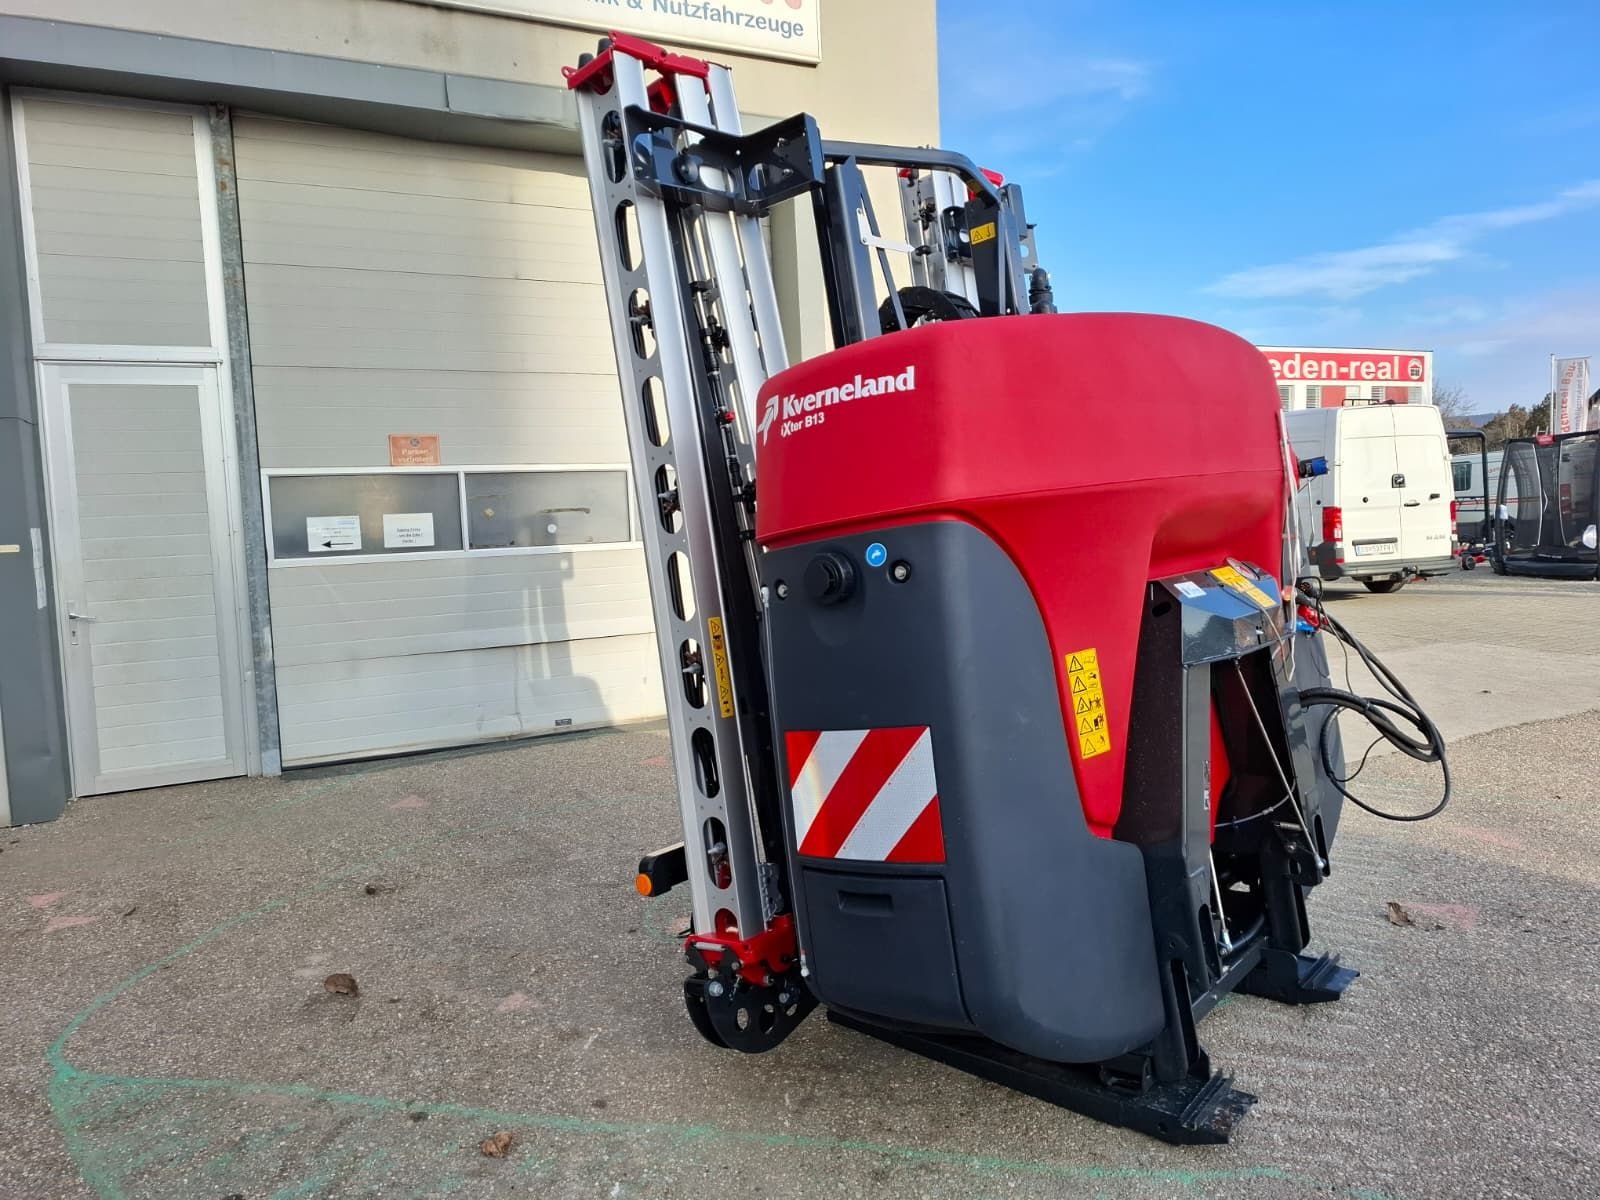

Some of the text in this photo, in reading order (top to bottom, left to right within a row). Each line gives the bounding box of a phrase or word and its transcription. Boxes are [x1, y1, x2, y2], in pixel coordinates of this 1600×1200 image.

[653, 0, 804, 39] Nutzfahrzeuge
[782, 365, 915, 420] Kverneland
[804, 411, 825, 428] B13
